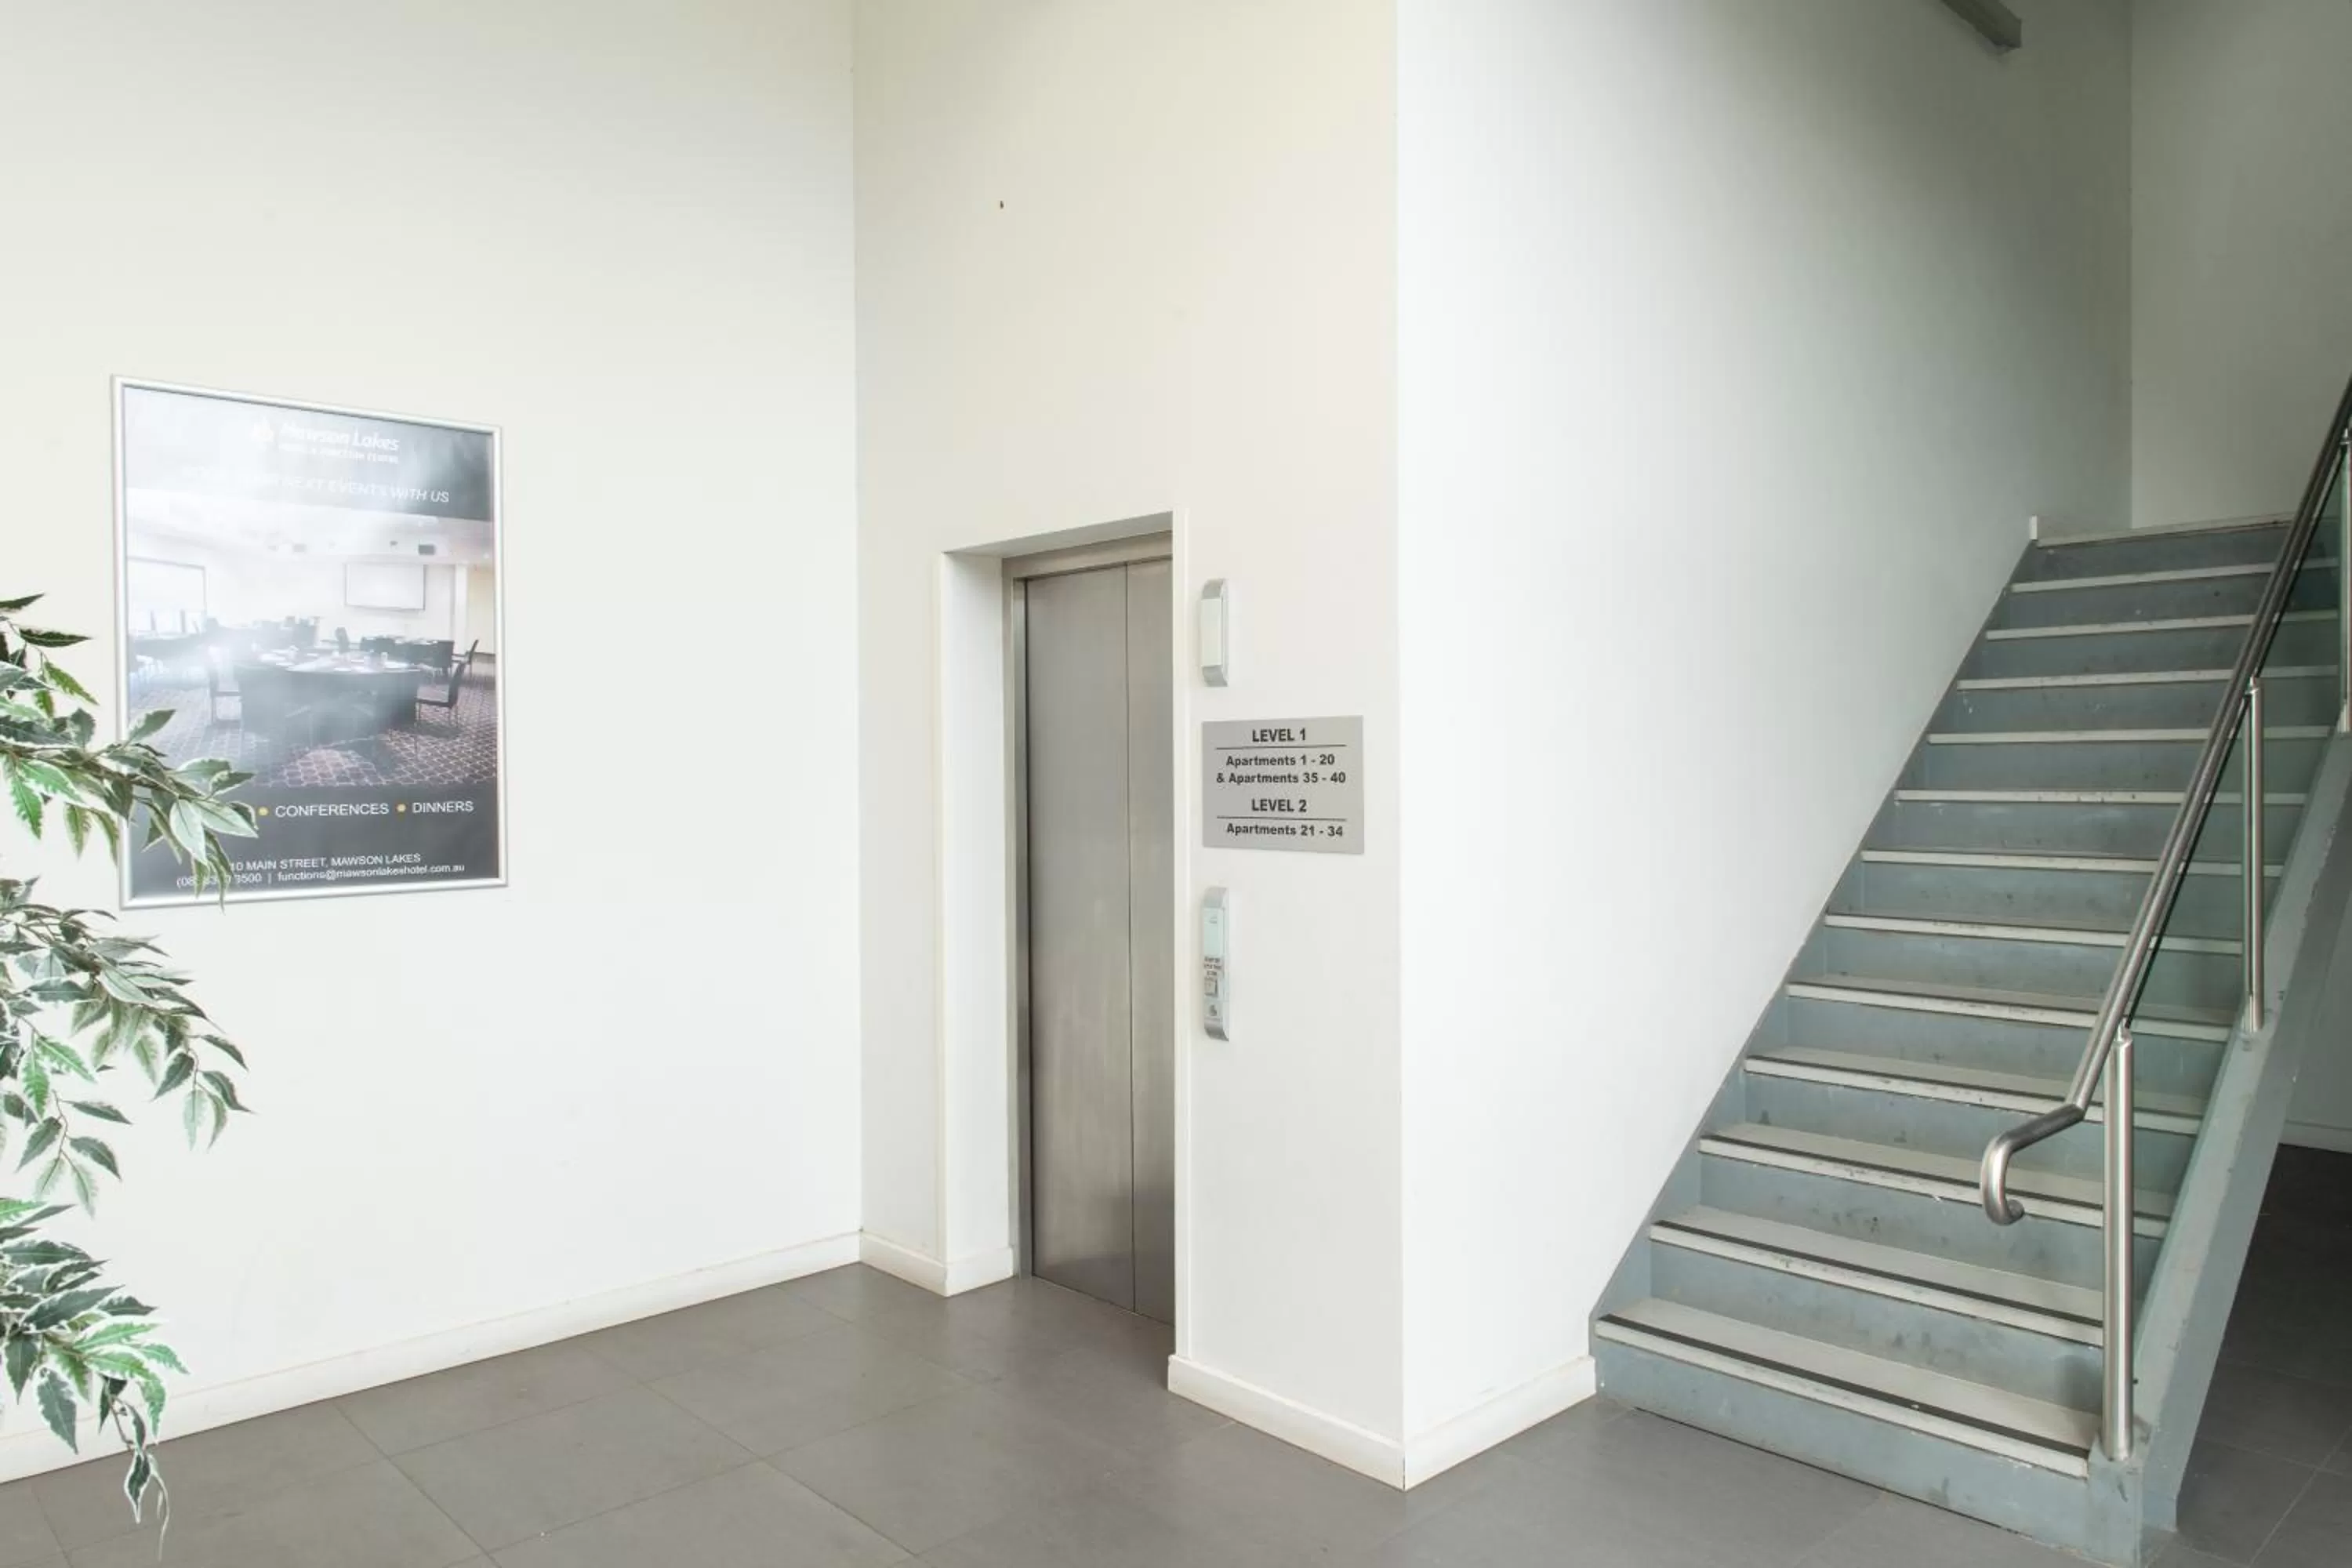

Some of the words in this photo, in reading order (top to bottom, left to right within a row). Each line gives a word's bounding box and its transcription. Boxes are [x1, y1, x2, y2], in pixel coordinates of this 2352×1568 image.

[353, 428, 401, 451] Lakes
[391, 485, 427, 502] WITH
[430, 490, 449, 503] US
[1252, 728, 1295, 742] LEVEL
[1300, 728, 1306, 741] 1
[1226, 755, 1296, 768] Apartments
[1301, 754, 1307, 765] 1
[1319, 754, 1335, 765] 20
[1216, 772, 1225, 783] &
[1229, 772, 1298, 786] Apartments
[1303, 772, 1318, 783] 35
[1330, 771, 1346, 783] 40
[275, 803, 390, 818] CONFERENCES
[412, 800, 474, 814] DINNERS
[1251, 798, 1294, 811] LEVEL
[1298, 799, 1307, 812] 2
[1226, 823, 1296, 836] Apartments
[1301, 825, 1315, 836] 21
[1327, 826, 1343, 837] 34
[246, 861, 276, 871] MAIN
[331, 855, 383, 867] MAWSON
[386, 853, 421, 863] LAKES
[278, 865, 465, 882] functions@mawsonlakeshotel.com.au
